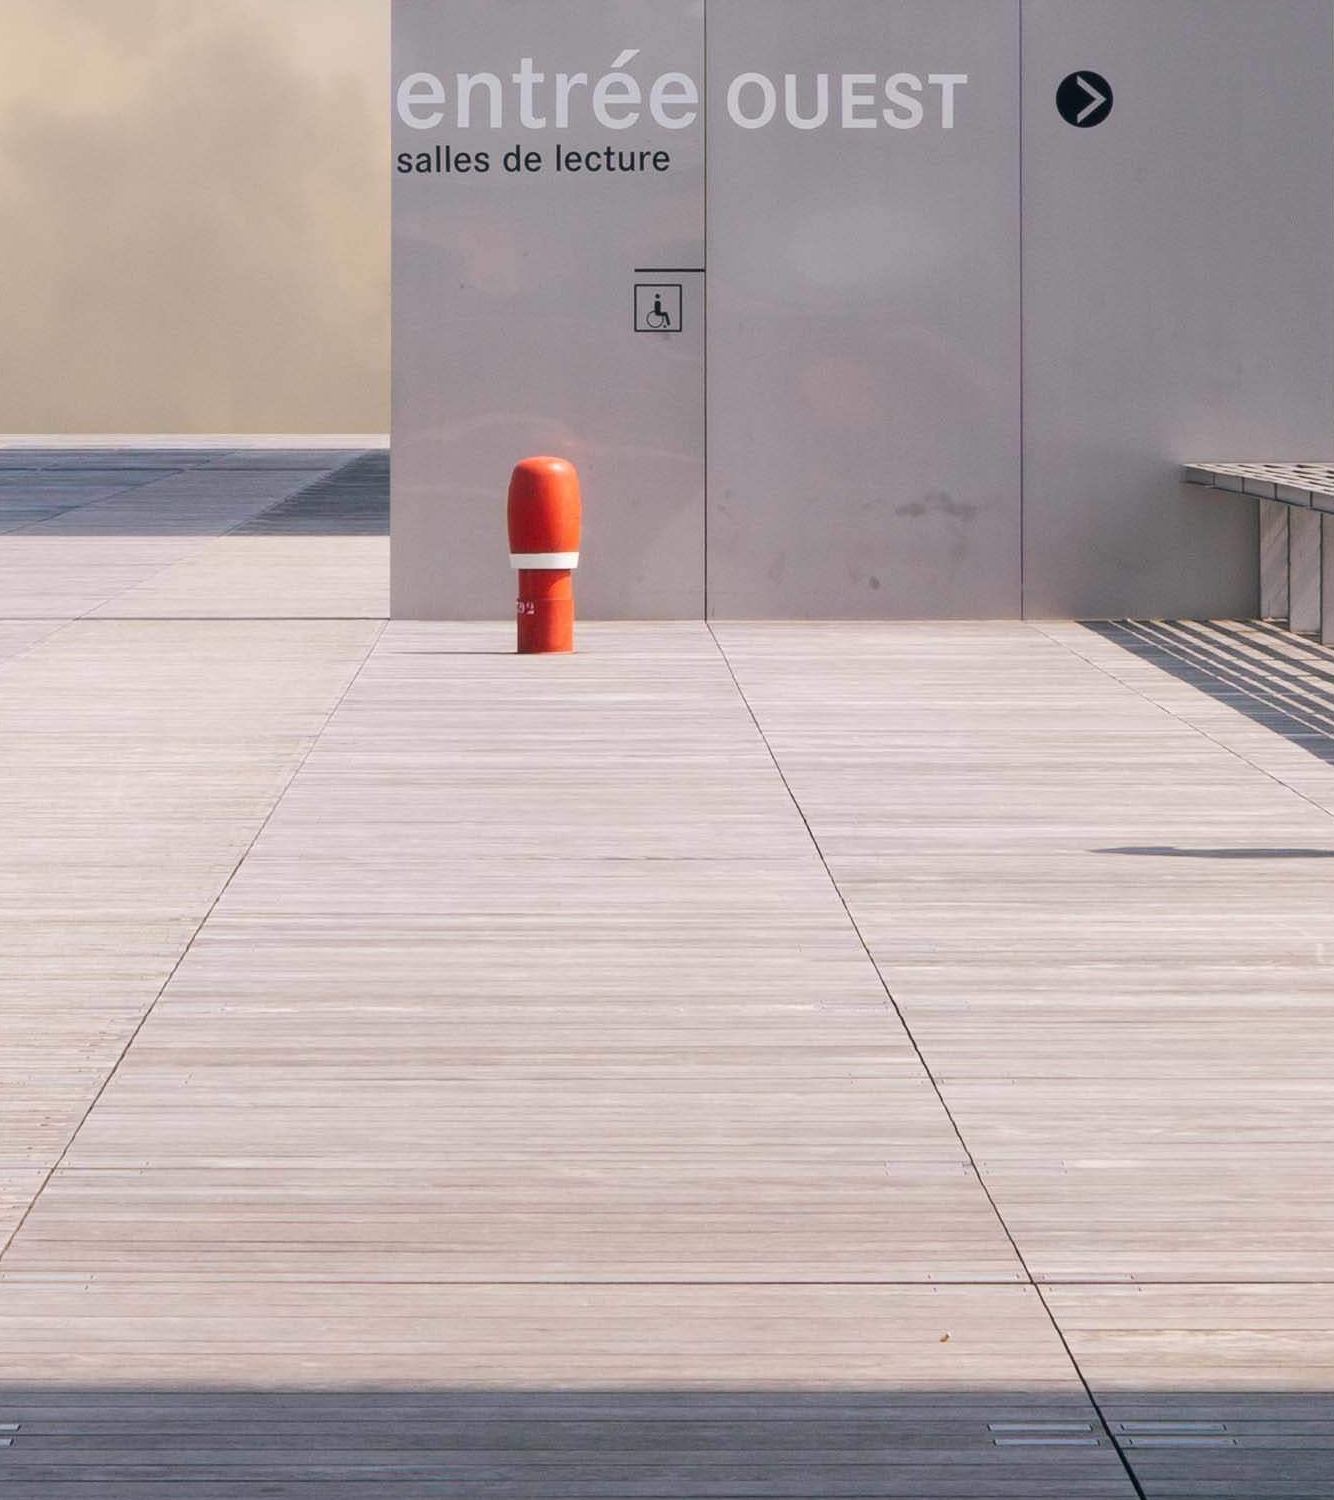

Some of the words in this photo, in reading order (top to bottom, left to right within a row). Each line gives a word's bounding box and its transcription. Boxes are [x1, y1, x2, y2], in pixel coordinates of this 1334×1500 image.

[396, 49, 699, 129] entrée
[727, 72, 967, 130] OUEST
[397, 145, 490, 173] salles
[503, 144, 542, 173] de
[556, 144, 671, 172] lecture
